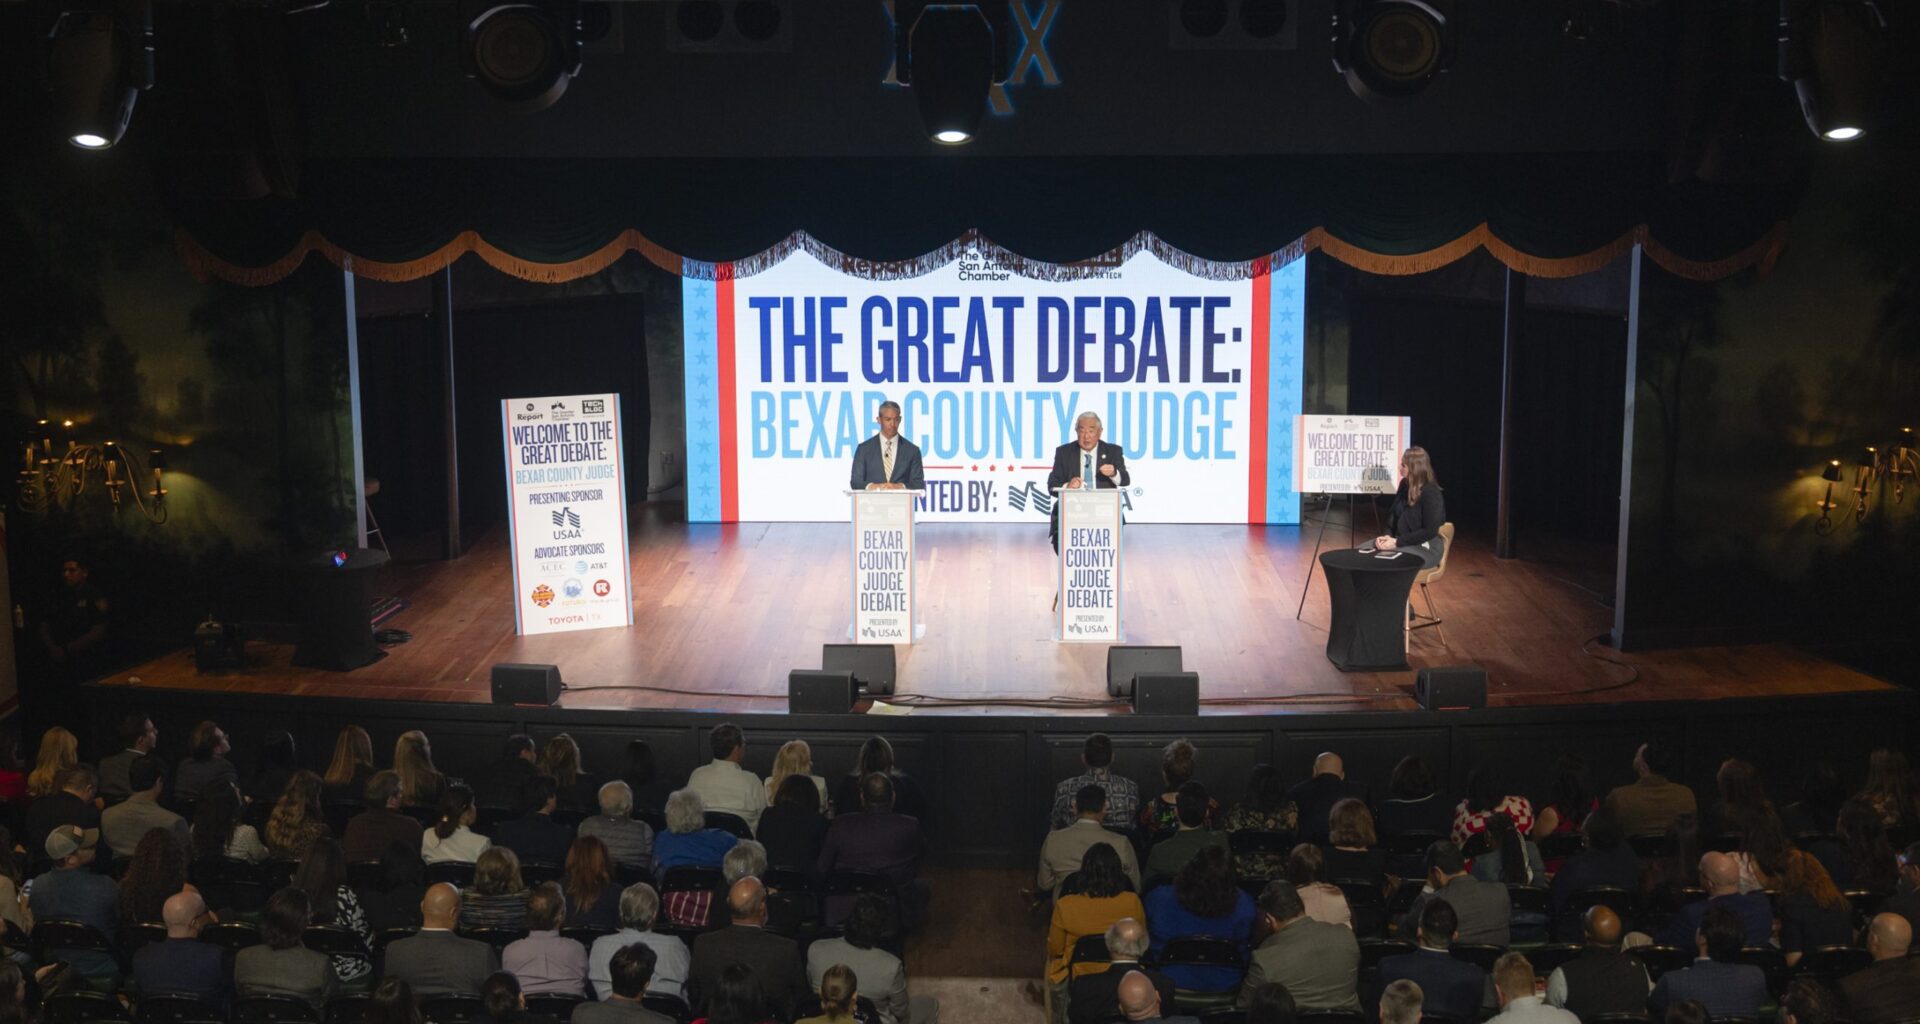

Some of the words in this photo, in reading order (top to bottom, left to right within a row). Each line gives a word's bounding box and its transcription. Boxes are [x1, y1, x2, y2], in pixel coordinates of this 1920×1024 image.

[958, 251, 979, 261] The
[958, 261, 980, 271] San
[983, 261, 1026, 272] Anto
[958, 271, 1010, 281] Chamber
[749, 296, 848, 383] THE
[861, 295, 1024, 384] GREAT
[1037, 296, 1242, 383] DEBATE:
[517, 413, 543, 421] Report
[904, 390, 1080, 459] COUNTY
[512, 423, 571, 446] WELCOME
[573, 422, 588, 442] TO
[590, 421, 613, 440] THE
[1308, 433, 1358, 450] WELCOME
[1360, 433, 1373, 451] TO
[1376, 434, 1395, 451] THE
[521, 444, 558, 465] GREAT
[560, 442, 607, 463] DEBATE:
[1314, 450, 1346, 467] GREAT
[1348, 450, 1388, 468] DEBATE:
[515, 469, 545, 485] BEXAR
[547, 466, 583, 483] COUNTY
[585, 464, 615, 480] JUDGE
[529, 491, 570, 505] PRESENTING
[571, 489, 603, 502] SPONSOR
[968, 480, 997, 512] BY:
[553, 529, 581, 540] USAA
[864, 530, 903, 549] BEXAR
[1071, 528, 1110, 547] BEXAR
[534, 545, 568, 559] ADVOCATE
[569, 542, 605, 557] SPONSORS
[1066, 548, 1115, 568] COUNTY
[590, 562, 608, 570] AT&T
[859, 551, 908, 570] COUNTY
[863, 572, 904, 591] JUDGE
[1070, 569, 1111, 588] JUDGE
[861, 593, 906, 612] DEBATE
[1067, 589, 1113, 608] DEBATE
[548, 615, 584, 625] TOYOTA
[1085, 624, 1108, 633] USAA
[878, 628, 902, 637] USAA
